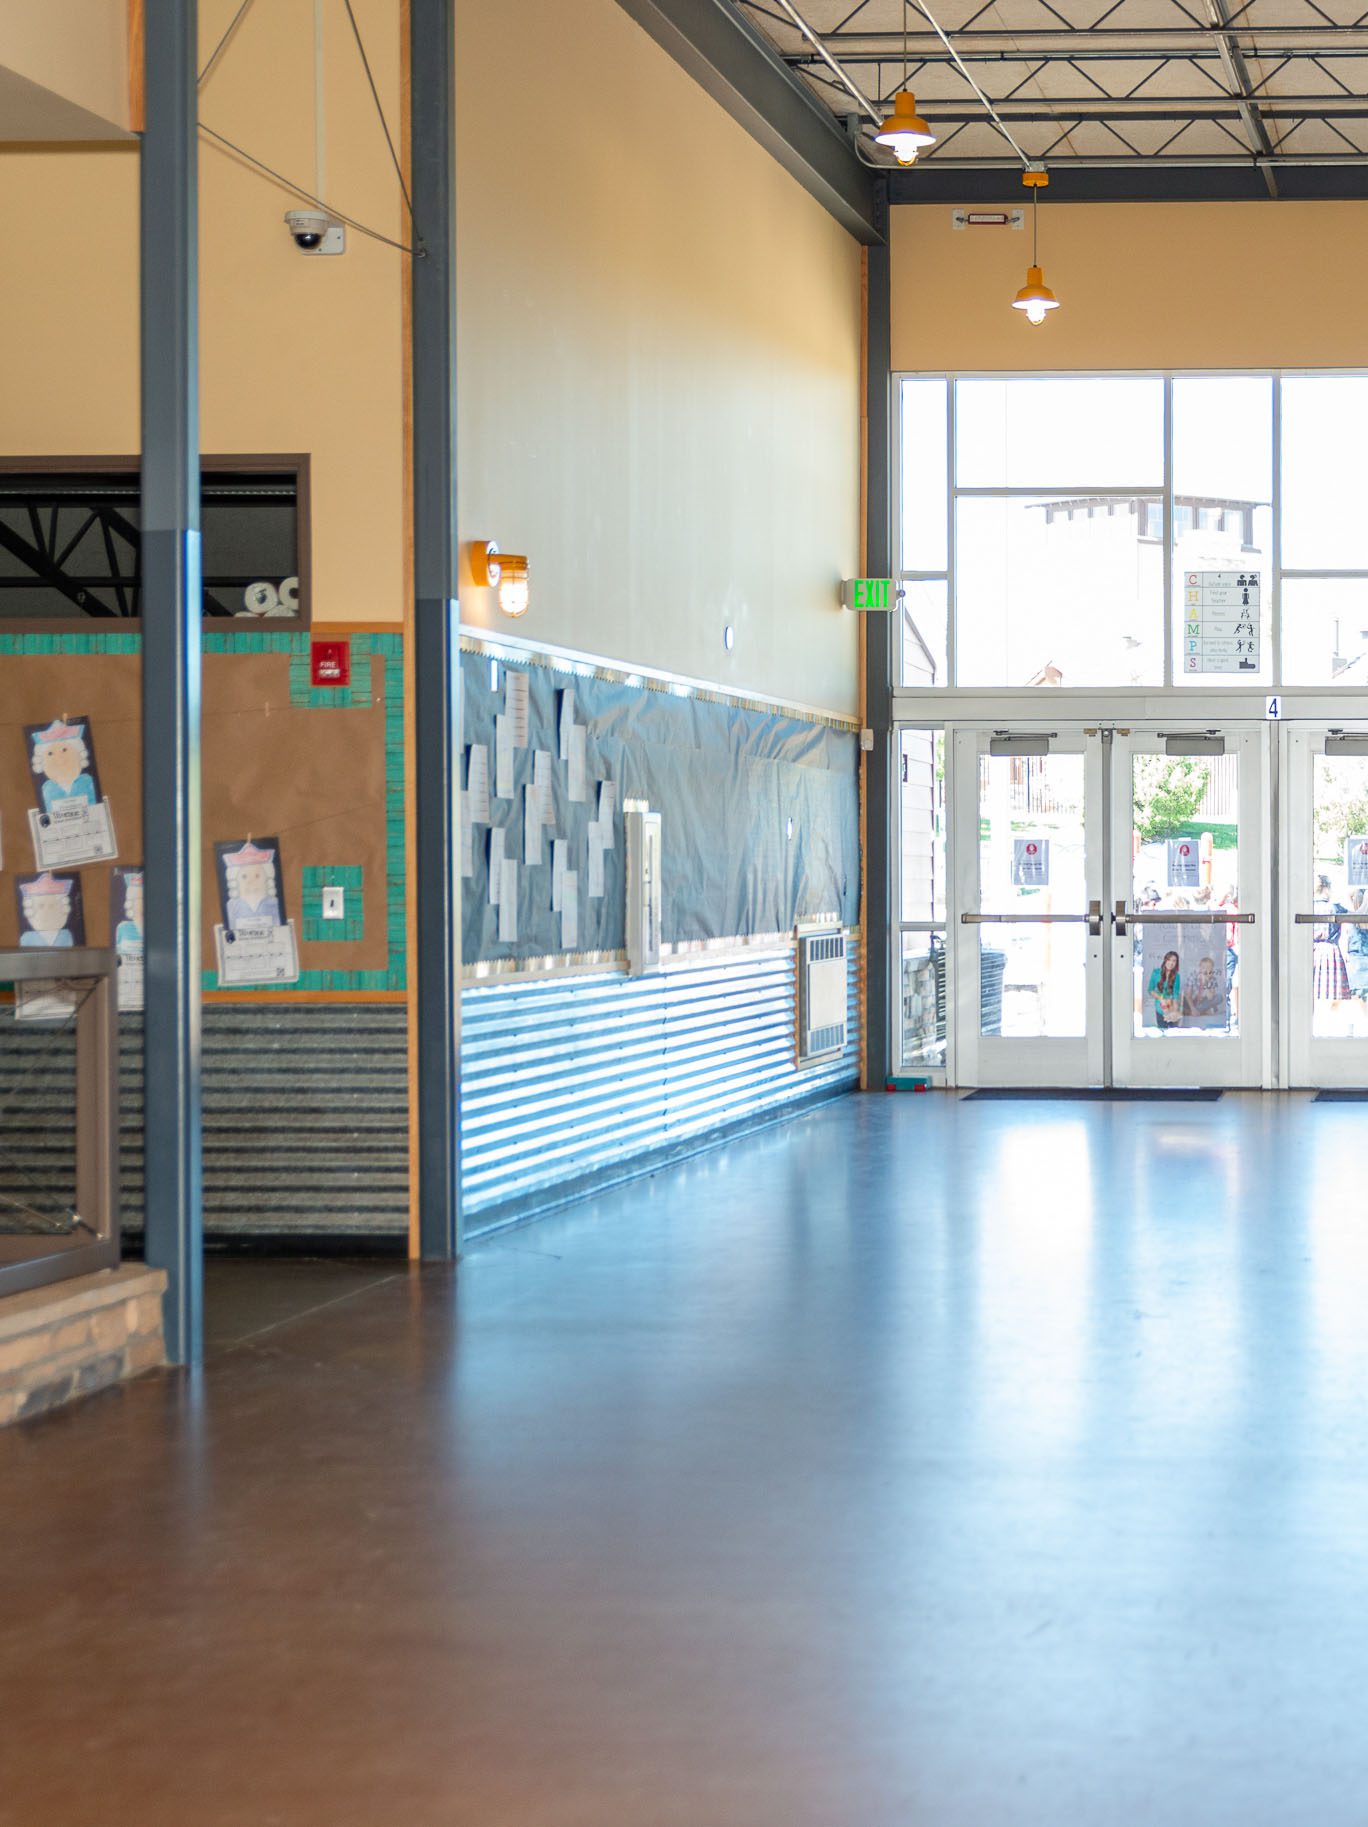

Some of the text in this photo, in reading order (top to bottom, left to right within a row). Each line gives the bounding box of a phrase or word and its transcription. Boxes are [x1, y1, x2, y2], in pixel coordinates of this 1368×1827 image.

[1189, 575, 1198, 585] C
[855, 580, 890, 608] EXIT
[1188, 591, 1198, 601] H
[1187, 624, 1200, 635] M
[1189, 641, 1197, 651] P
[1190, 658, 1196, 667] S
[1268, 697, 1279, 718] 4
